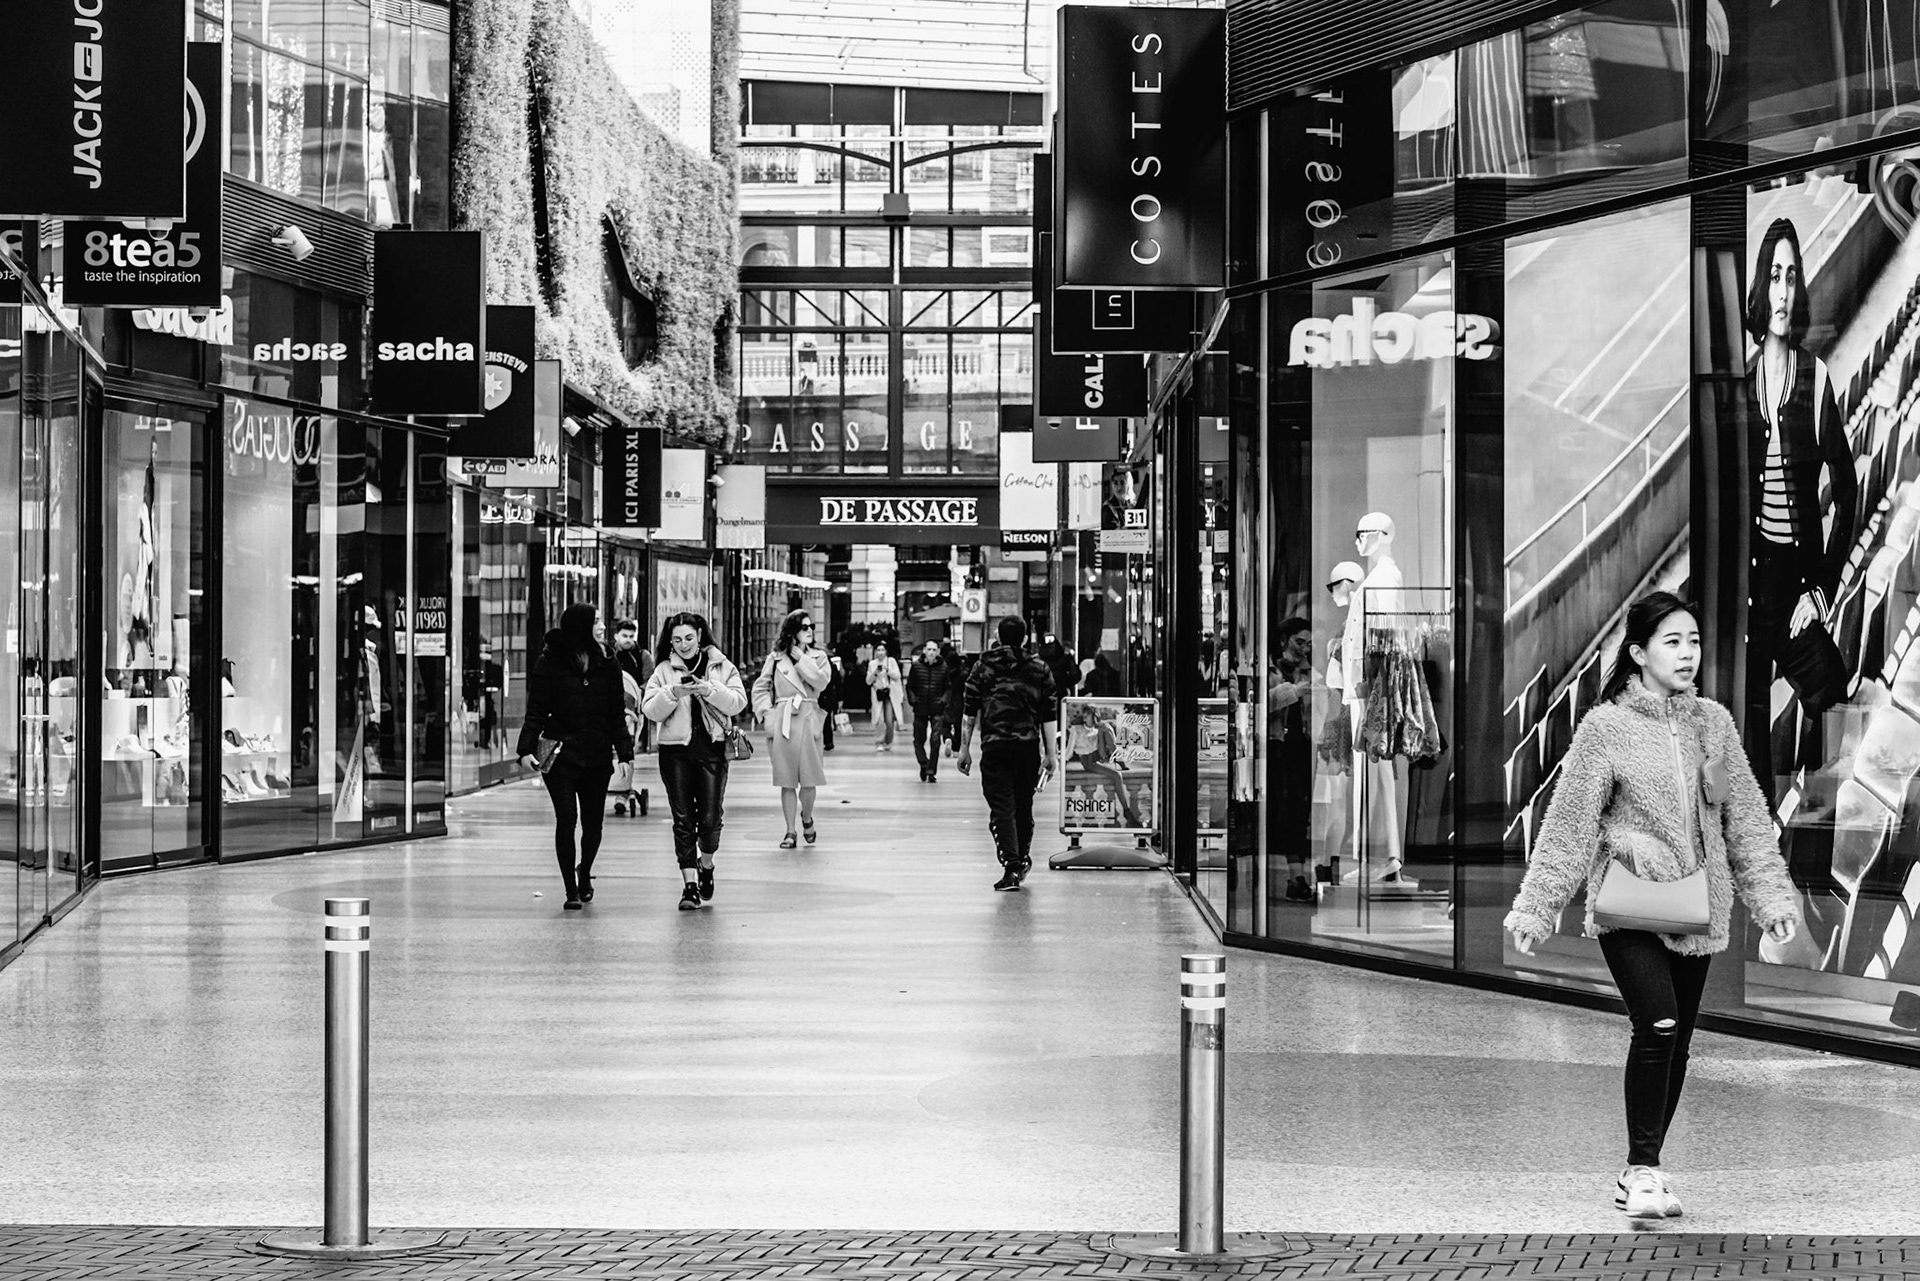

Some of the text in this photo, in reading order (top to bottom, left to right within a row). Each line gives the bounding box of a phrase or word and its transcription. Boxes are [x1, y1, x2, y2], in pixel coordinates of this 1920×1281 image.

[73, 83, 103, 189] JACK
[1130, 33, 1162, 265] COSTES
[84, 231, 201, 267] 8tea5
[84, 269, 201, 284] taste the inspiration
[378, 336, 474, 361] sacha
[1084, 353, 1104, 409] CAL
[736, 421, 973, 453] PASSGE
[487, 463, 506, 474] AED
[625, 431, 639, 523] ICI PARIS XL
[820, 500, 978, 523] DE PASSAGE
[1003, 534, 1048, 543] NELSON
[1066, 800, 1114, 812] FISHNET
